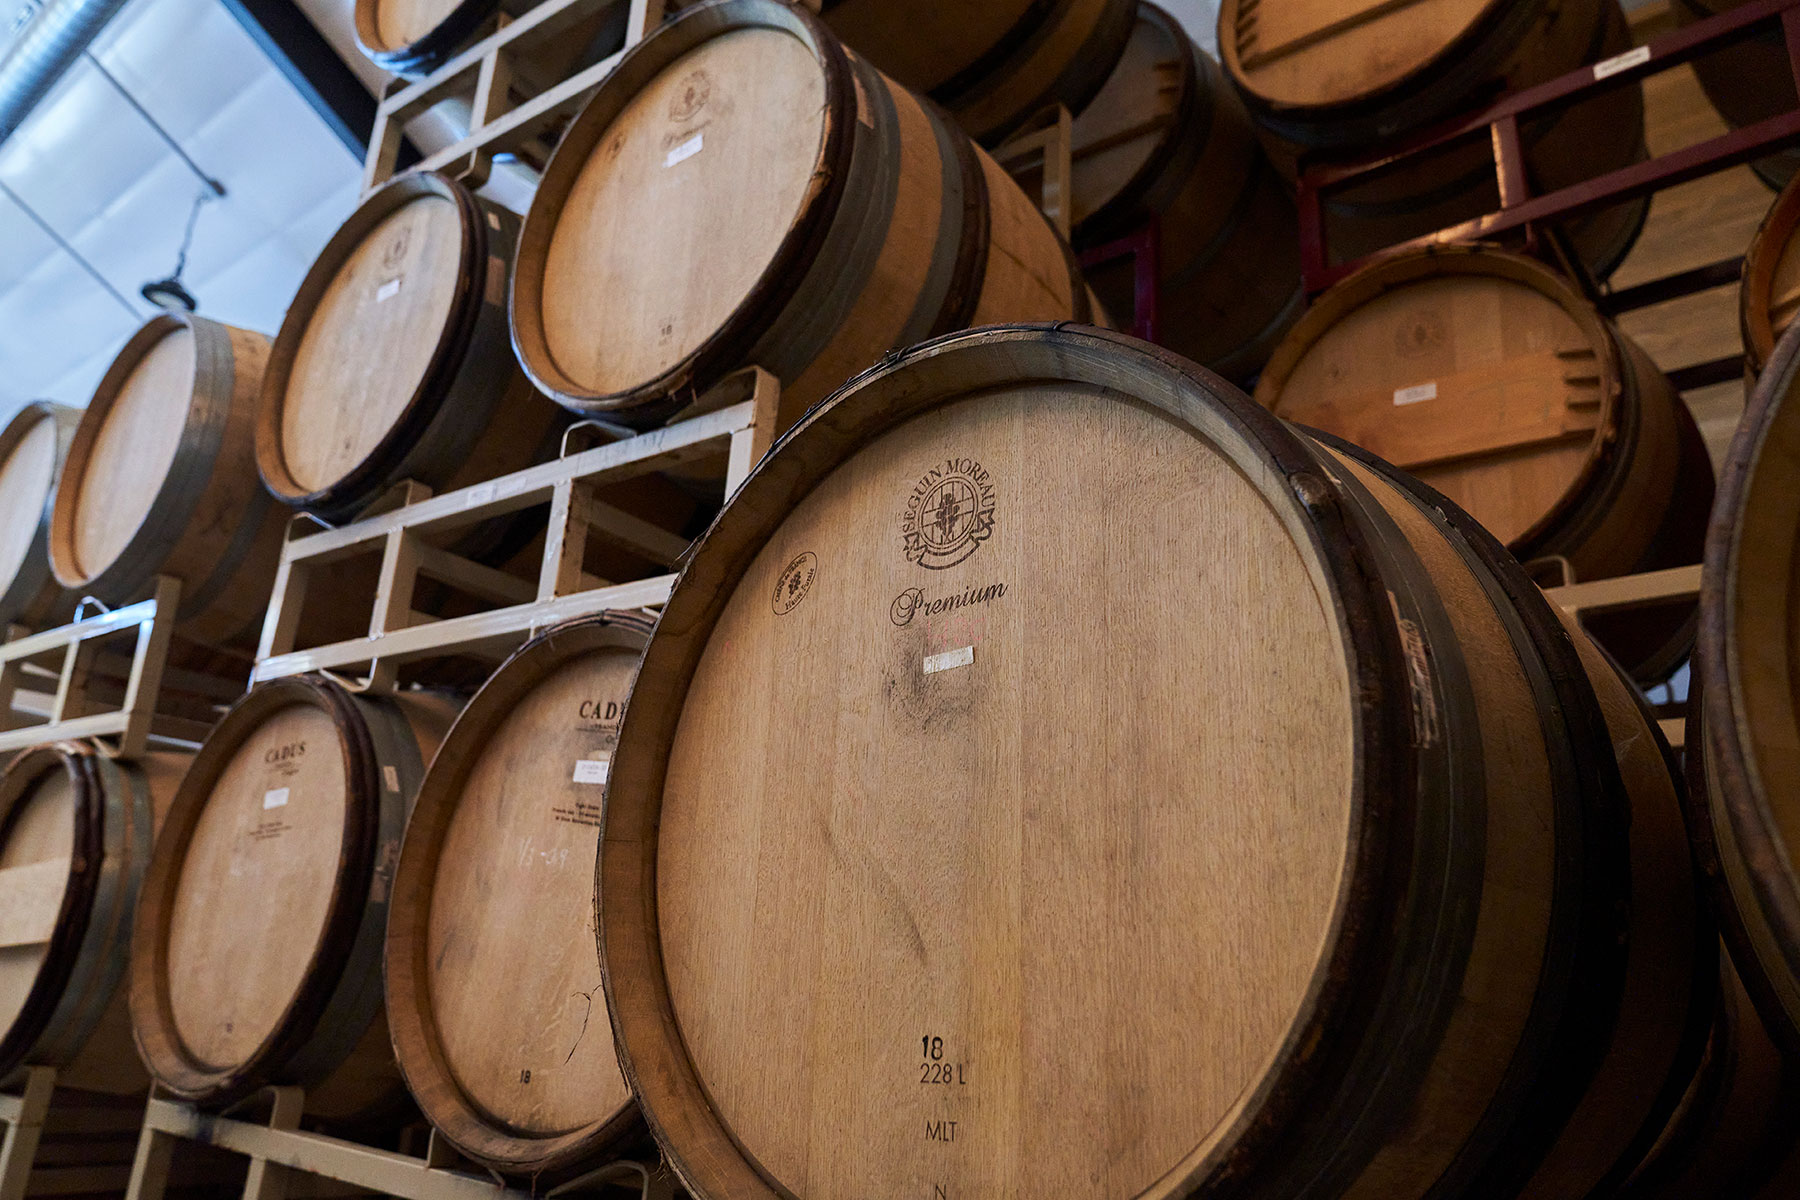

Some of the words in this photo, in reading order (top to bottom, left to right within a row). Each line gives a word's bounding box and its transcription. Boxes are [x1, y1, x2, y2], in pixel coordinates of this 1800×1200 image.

[902, 464, 943, 534] SEGUIN
[945, 457, 996, 508] MOREAU
[889, 583, 1009, 626] Premium
[579, 700, 625, 720] CAD
[922, 1034, 943, 1061] 18
[519, 1069, 532, 1085] 18
[920, 1063, 952, 1084] 228
[959, 1063, 966, 1085] L
[925, 1120, 957, 1142] MLT
